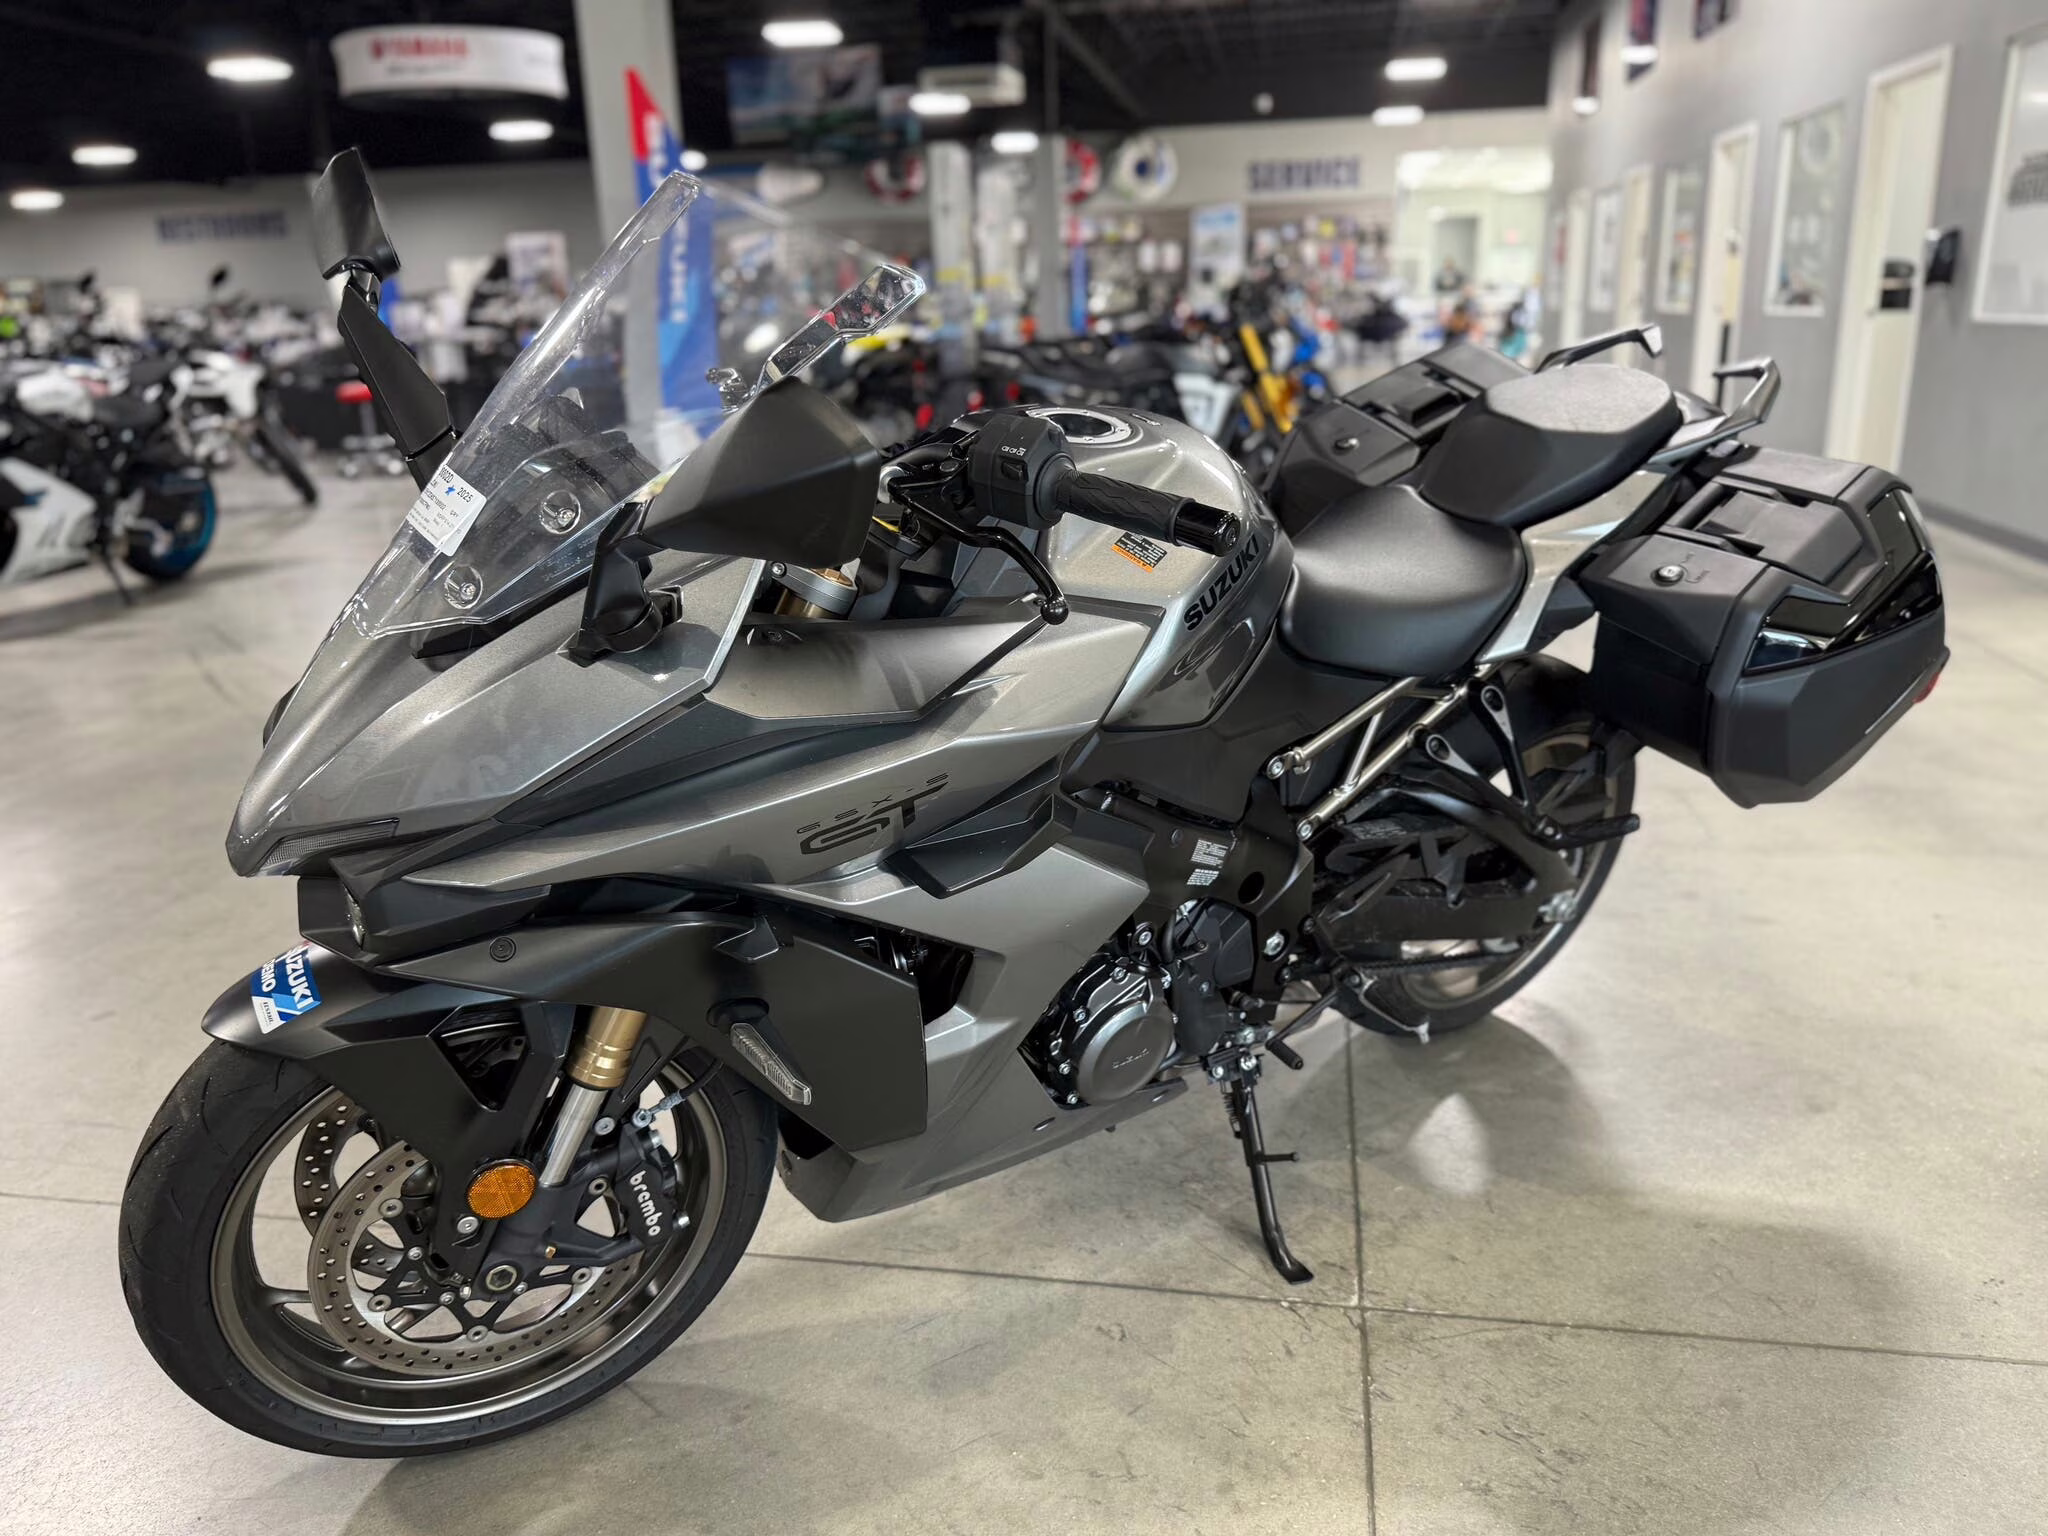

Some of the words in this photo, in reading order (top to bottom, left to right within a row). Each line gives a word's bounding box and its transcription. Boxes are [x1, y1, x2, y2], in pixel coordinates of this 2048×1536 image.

[457, 487, 474, 503] 2025
[1183, 533, 1260, 631] SUZUKI
[800, 782, 949, 855] GT
[629, 1169, 663, 1237] brembo
